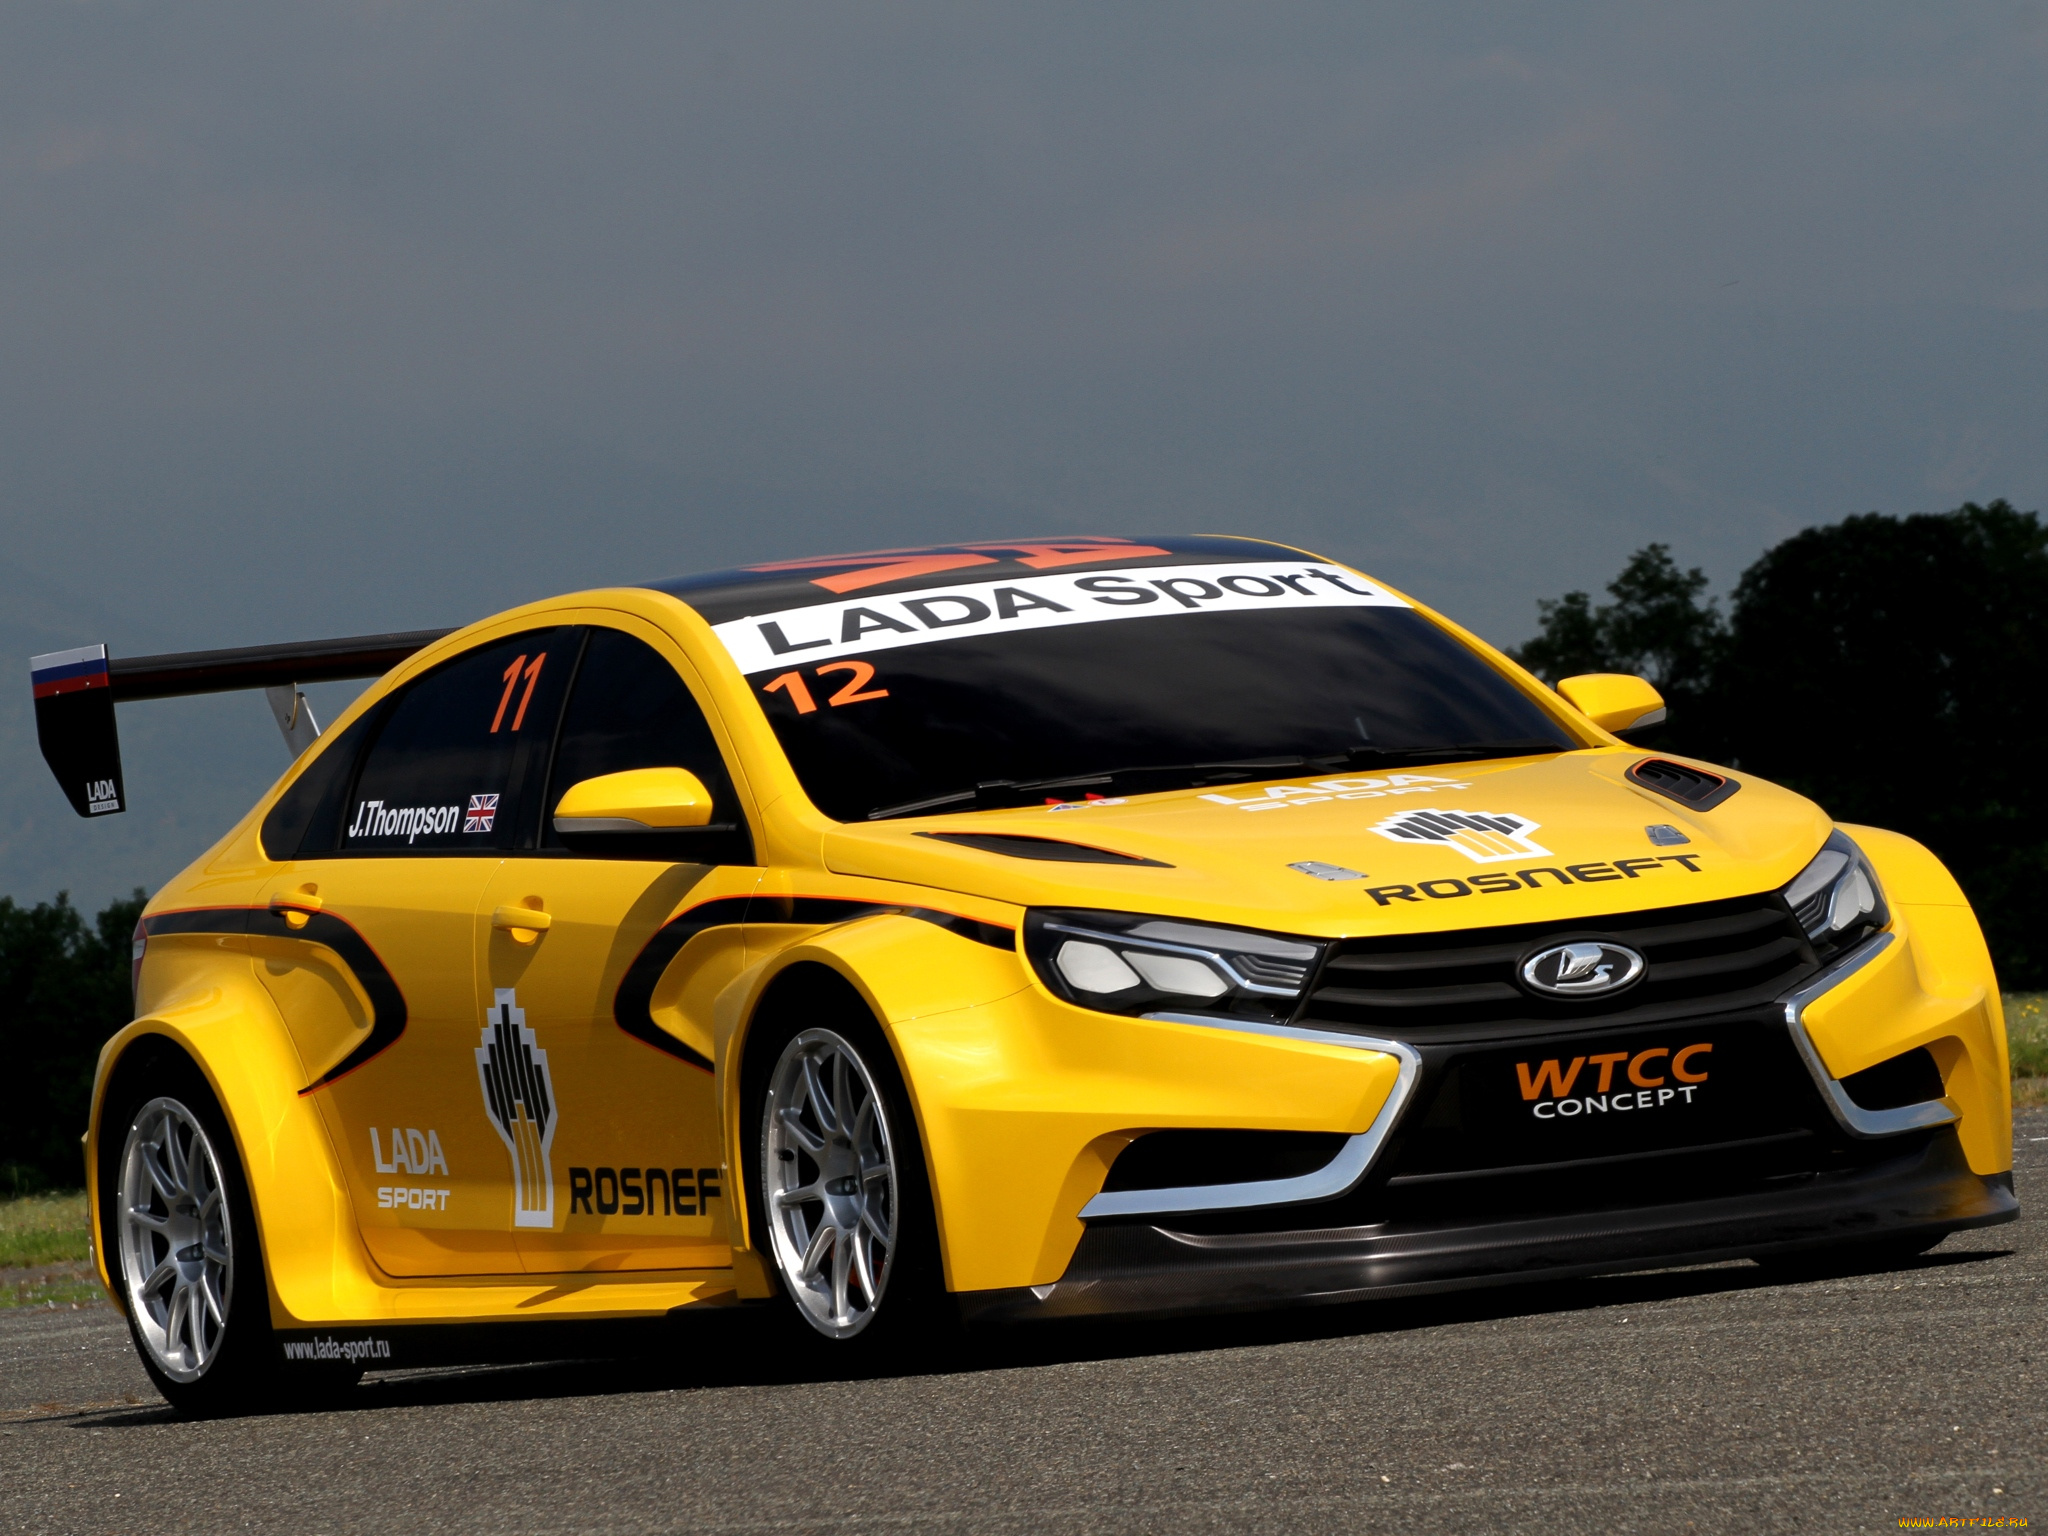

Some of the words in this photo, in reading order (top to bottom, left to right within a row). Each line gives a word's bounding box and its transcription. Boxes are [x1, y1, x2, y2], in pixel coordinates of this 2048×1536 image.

[757, 587, 1075, 657] LADA
[1074, 568, 1375, 609] Sport
[490, 652, 547, 733] 11
[763, 660, 890, 715] 12
[86, 779, 117, 802] LADA
[1196, 774, 1460, 805] LADA
[1239, 782, 1473, 811] SPORT
[349, 800, 460, 844] J.Thompson
[1364, 853, 1703, 907] ROSNEFT
[1516, 1043, 1713, 1101] WTCC
[1533, 1086, 1698, 1119] CONCEPT
[369, 1127, 449, 1176] LADA
[378, 1187, 451, 1211] SPORT
[568, 1166, 724, 1217] ROSNEF
[283, 1336, 391, 1364] www.lada-sport.ru
